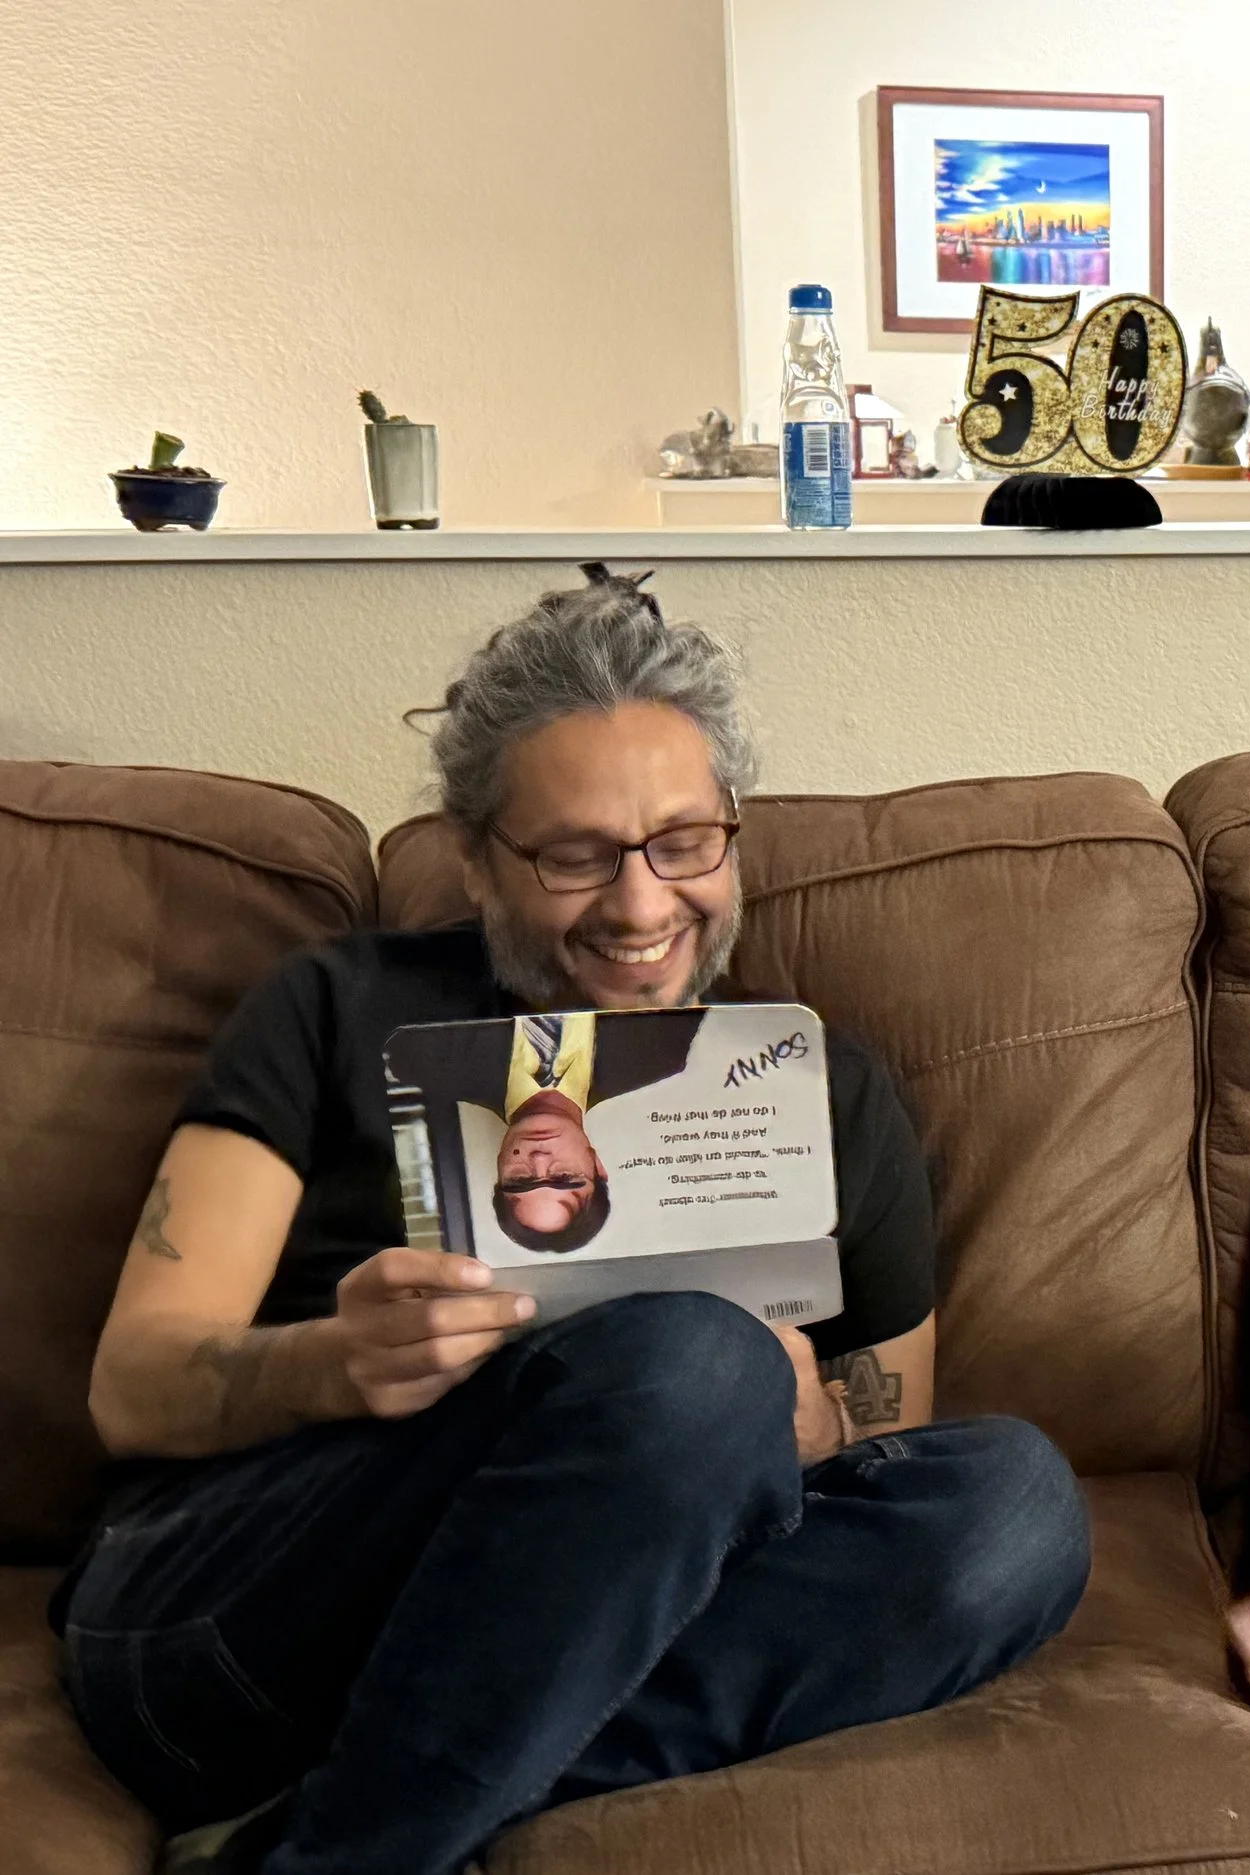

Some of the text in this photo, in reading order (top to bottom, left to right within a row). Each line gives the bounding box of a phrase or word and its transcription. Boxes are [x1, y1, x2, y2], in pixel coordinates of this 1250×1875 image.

[957, 284, 1188, 477] 50
[1099, 366, 1159, 399] Happy
[1081, 393, 1172, 427] Birthday
[724, 1032, 808, 1088] SONNY
